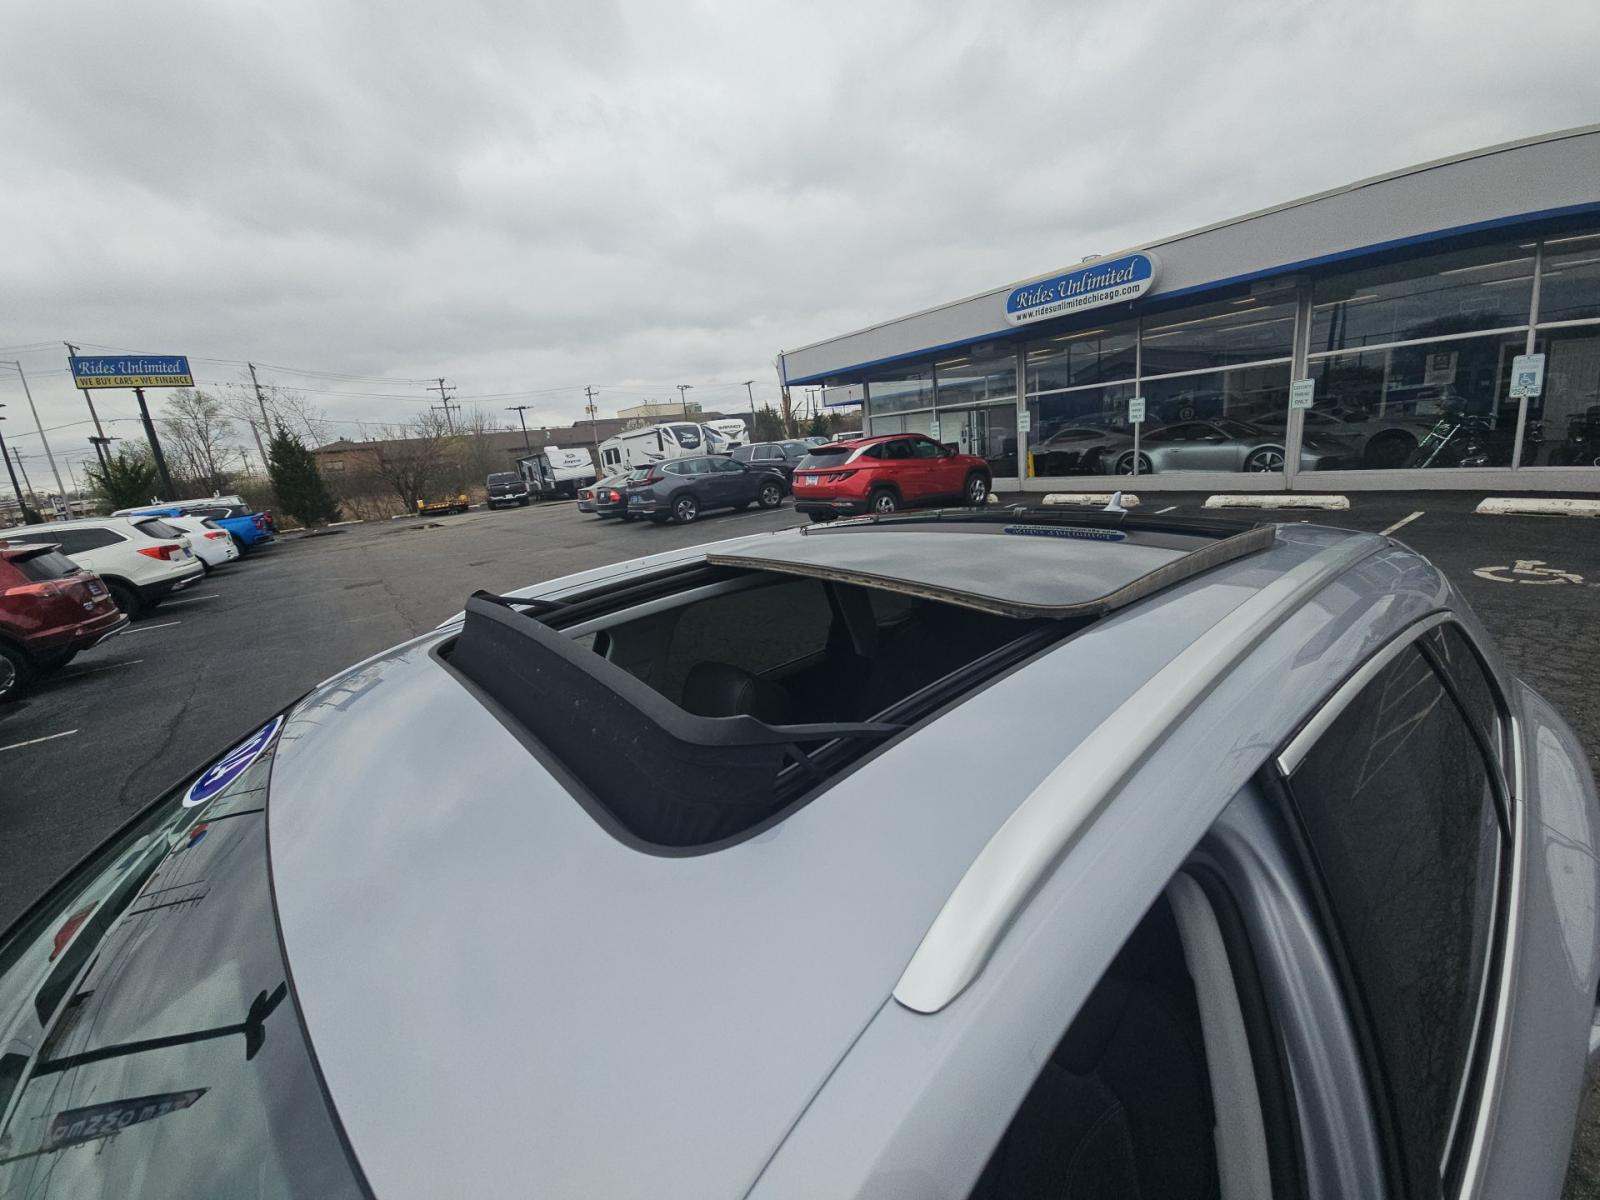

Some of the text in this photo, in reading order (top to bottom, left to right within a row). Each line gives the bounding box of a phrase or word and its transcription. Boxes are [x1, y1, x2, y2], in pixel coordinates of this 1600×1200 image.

[1016, 257, 1138, 309] Rides Unlimited
[1016, 283, 1140, 321] www.ridesunlimitedchicago.com
[78, 359, 181, 374] Rides Unlimited
[80, 375, 190, 386] WE BUY CARS WE FINANCE
